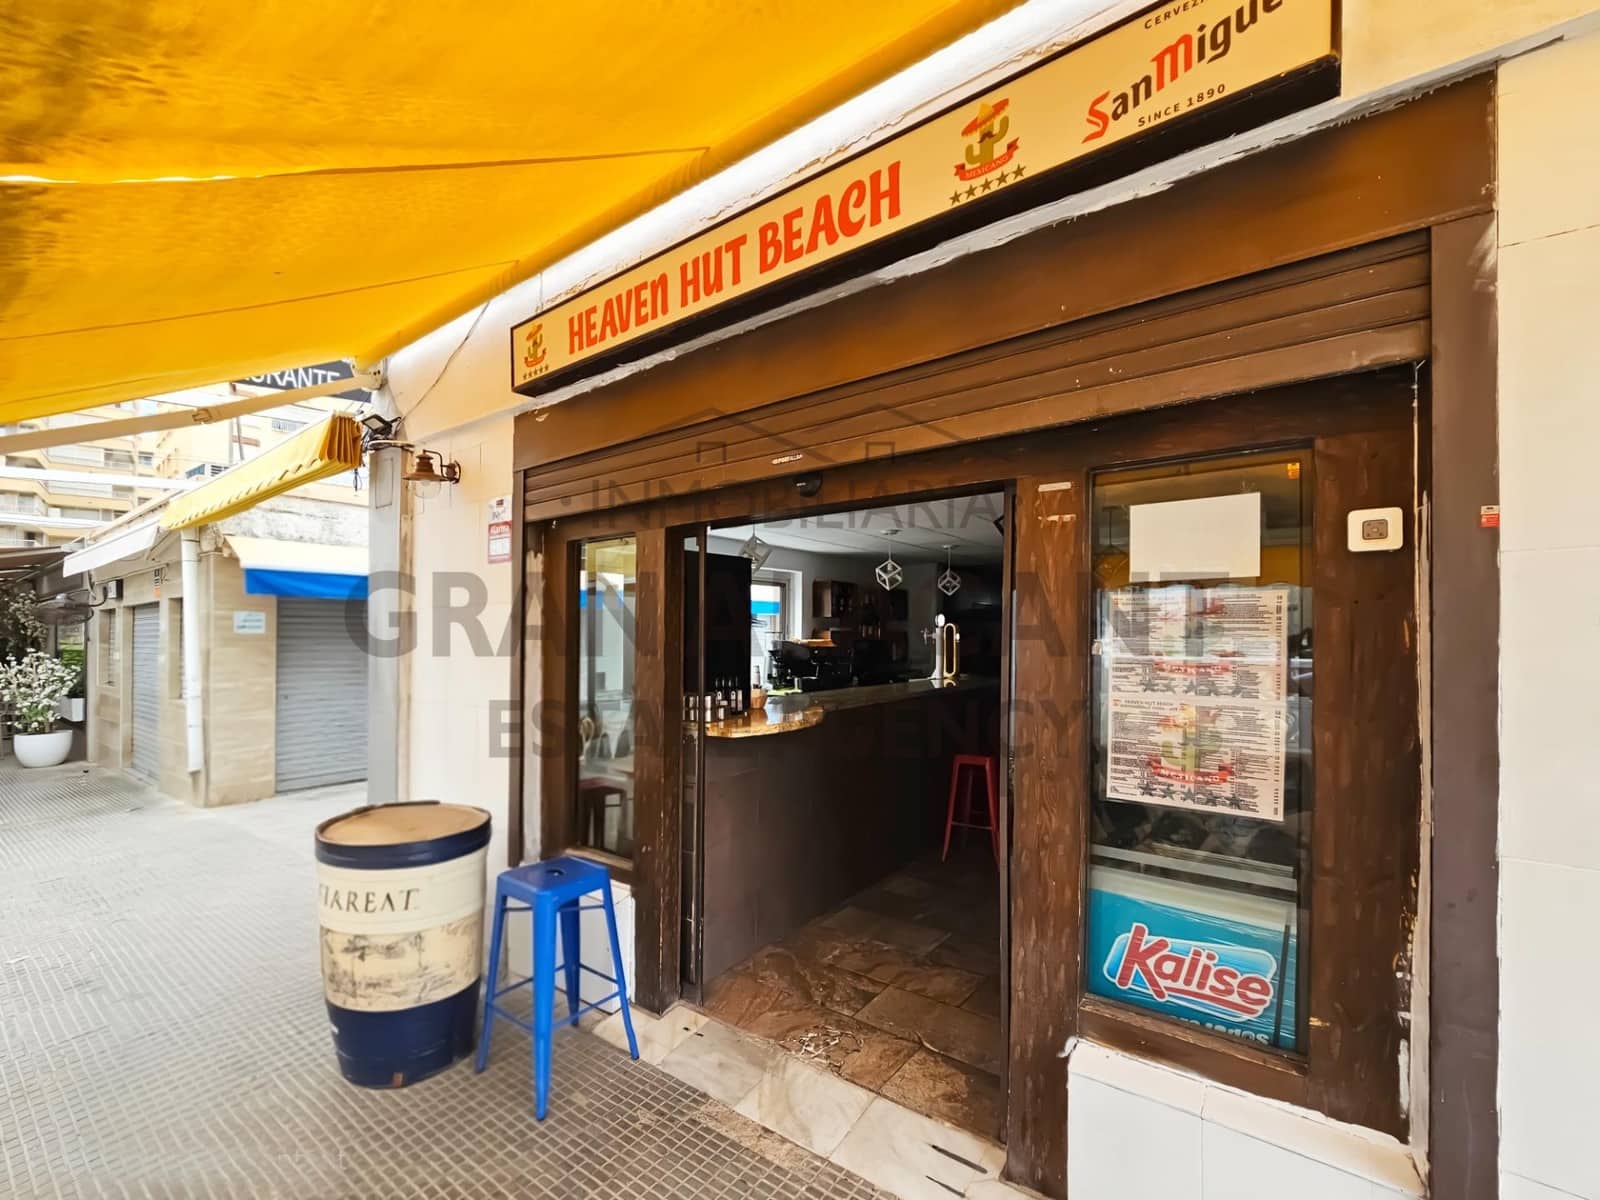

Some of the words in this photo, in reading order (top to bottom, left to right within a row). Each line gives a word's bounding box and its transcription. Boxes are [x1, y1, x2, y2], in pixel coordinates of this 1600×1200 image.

[1144, 0, 1208, 30] CERVEZ
[1137, 103, 1181, 127] SINCE
[1186, 84, 1226, 108] 1890
[568, 271, 669, 354] HEAVEN
[680, 233, 748, 308] HUT
[758, 160, 902, 274] BEACH
[1117, 924, 1272, 1006] Kalise
